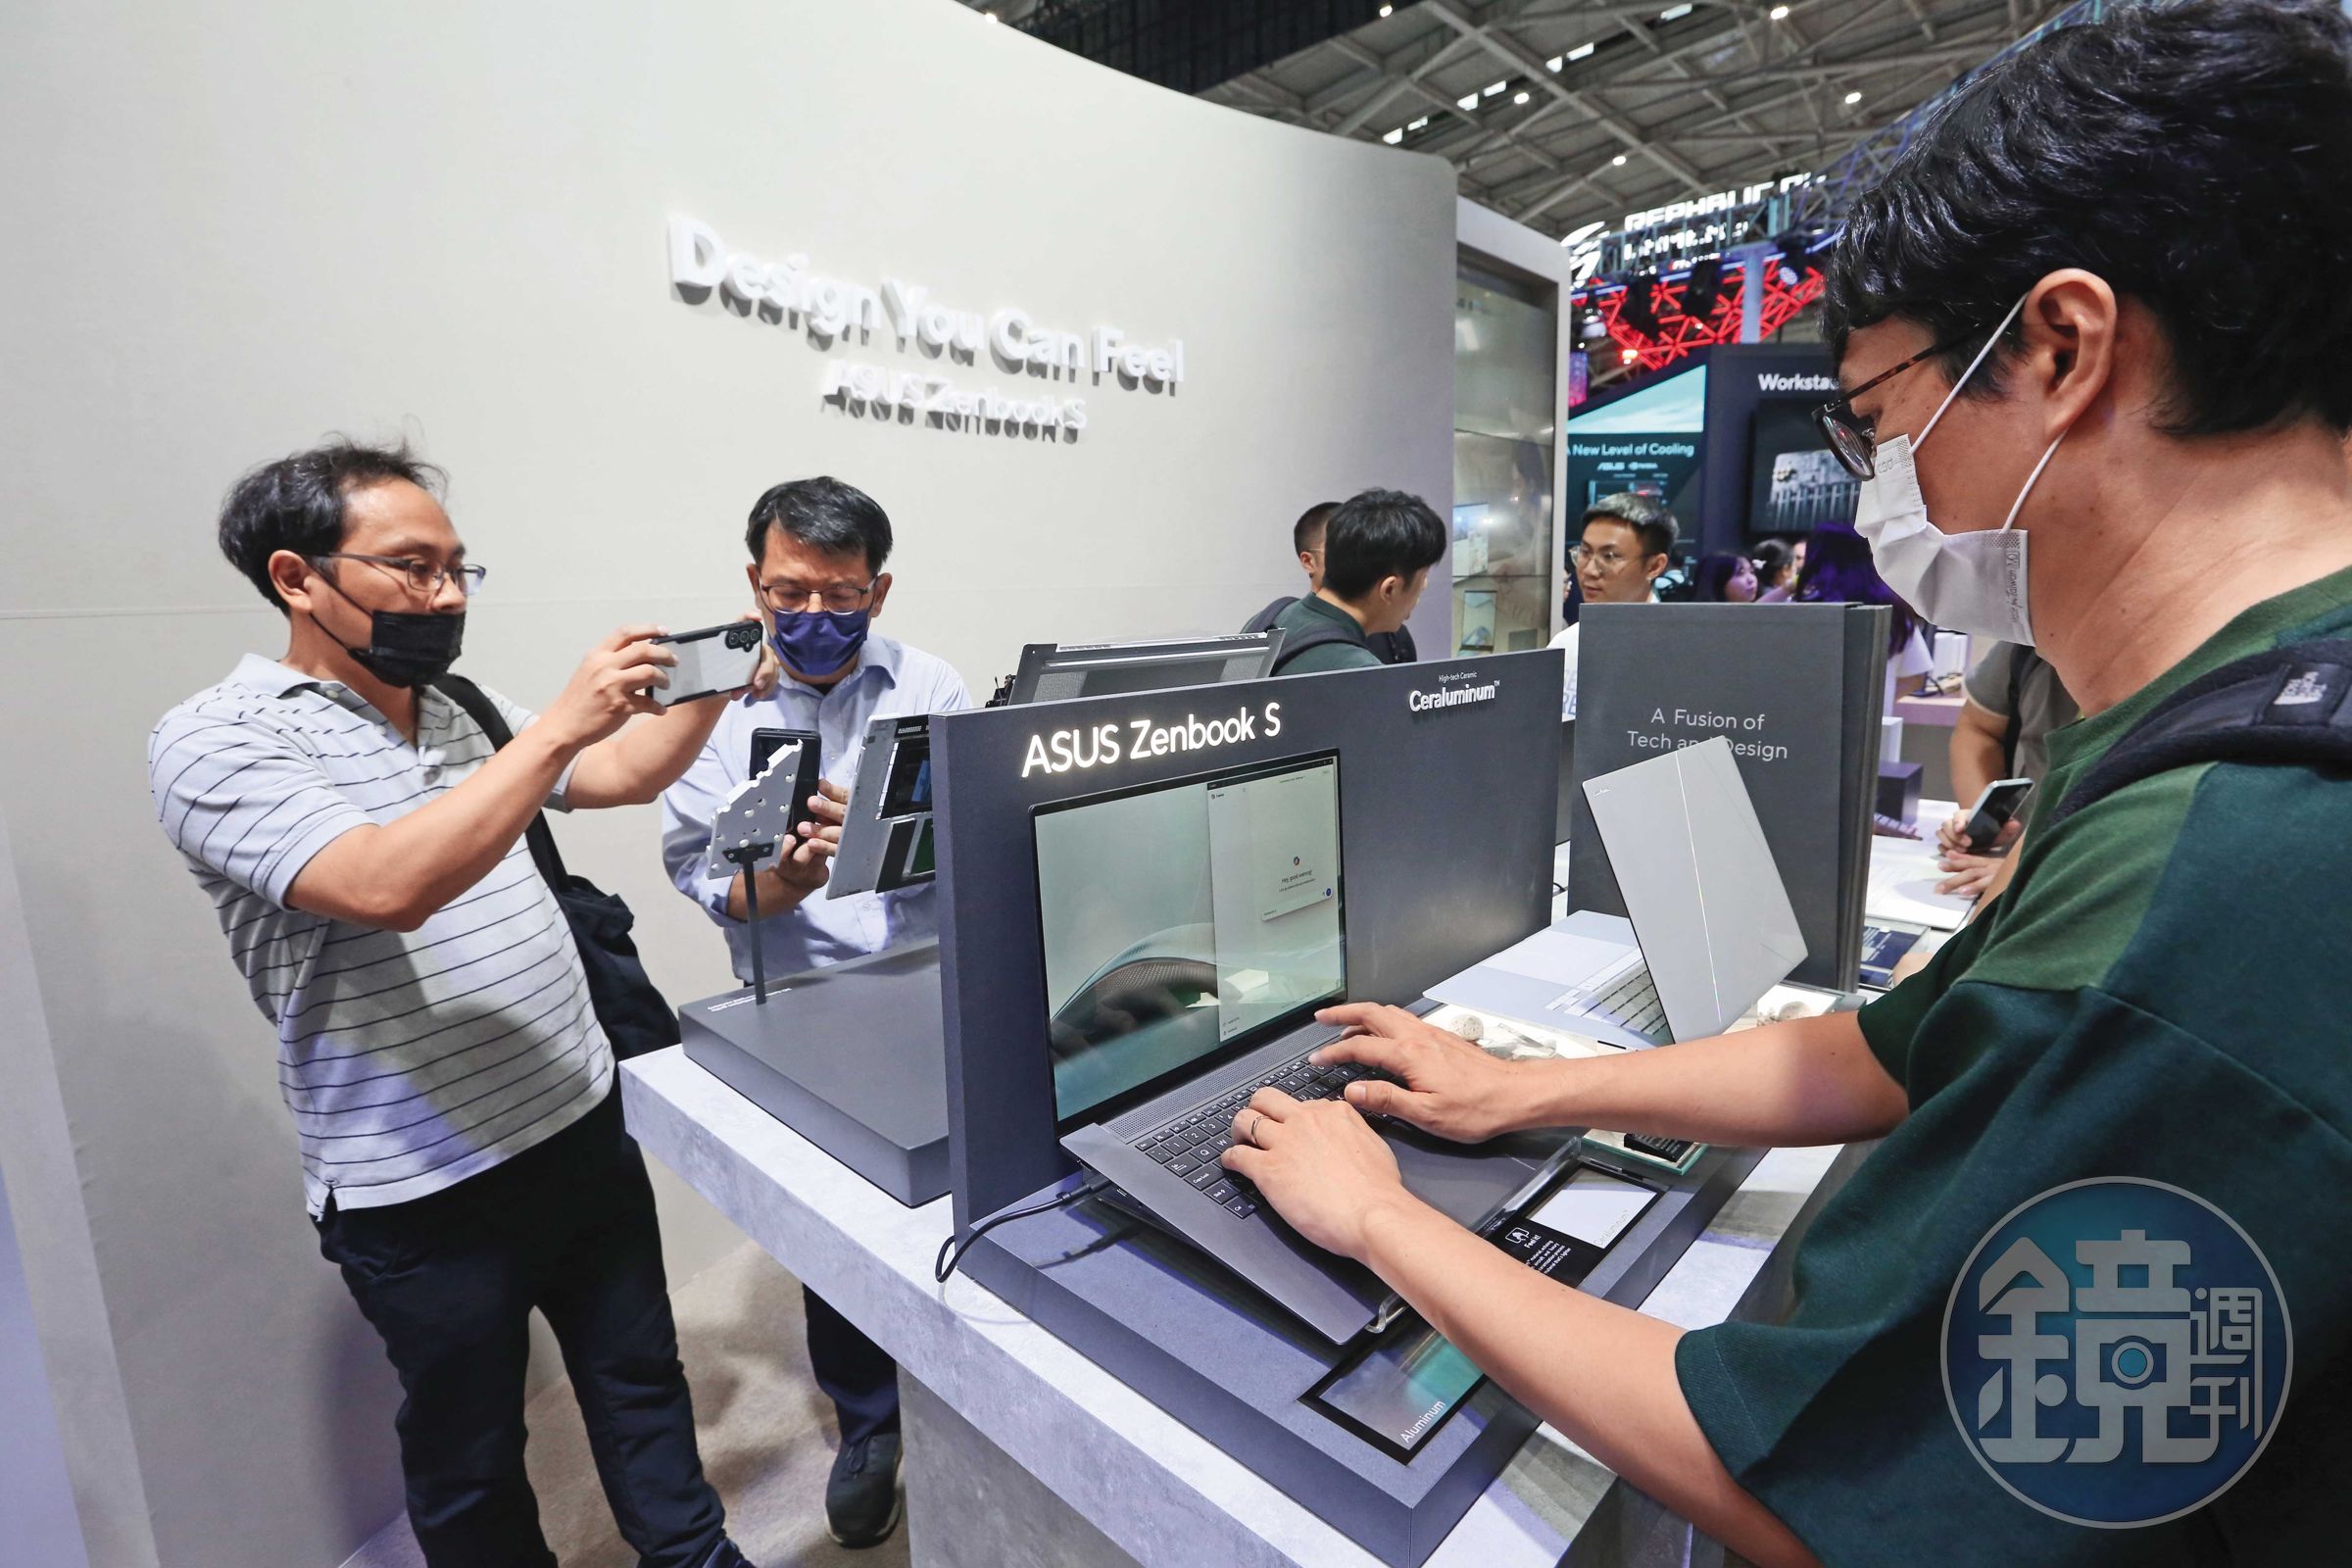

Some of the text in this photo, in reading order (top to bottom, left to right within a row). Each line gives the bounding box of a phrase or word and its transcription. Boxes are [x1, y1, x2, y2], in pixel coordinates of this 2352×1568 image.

[668, 217, 1185, 382] Design You Can Feel
[822, 359, 1087, 429] ASUS Zenbook S
[1573, 444, 1599, 457] New
[1601, 443, 1634, 457] Level
[1635, 443, 1647, 456] of
[1648, 443, 1695, 459] Cooling
[1439, 671, 1478, 684] High-tech Ceramic
[1650, 708, 1765, 730] A Fusion of
[1021, 702, 1282, 778] ASUS Zenbook S
[1627, 730, 1672, 750] Tech
[1524, 1238, 1537, 1249] Feel
[1399, 1400, 1446, 1444] Aluminum
